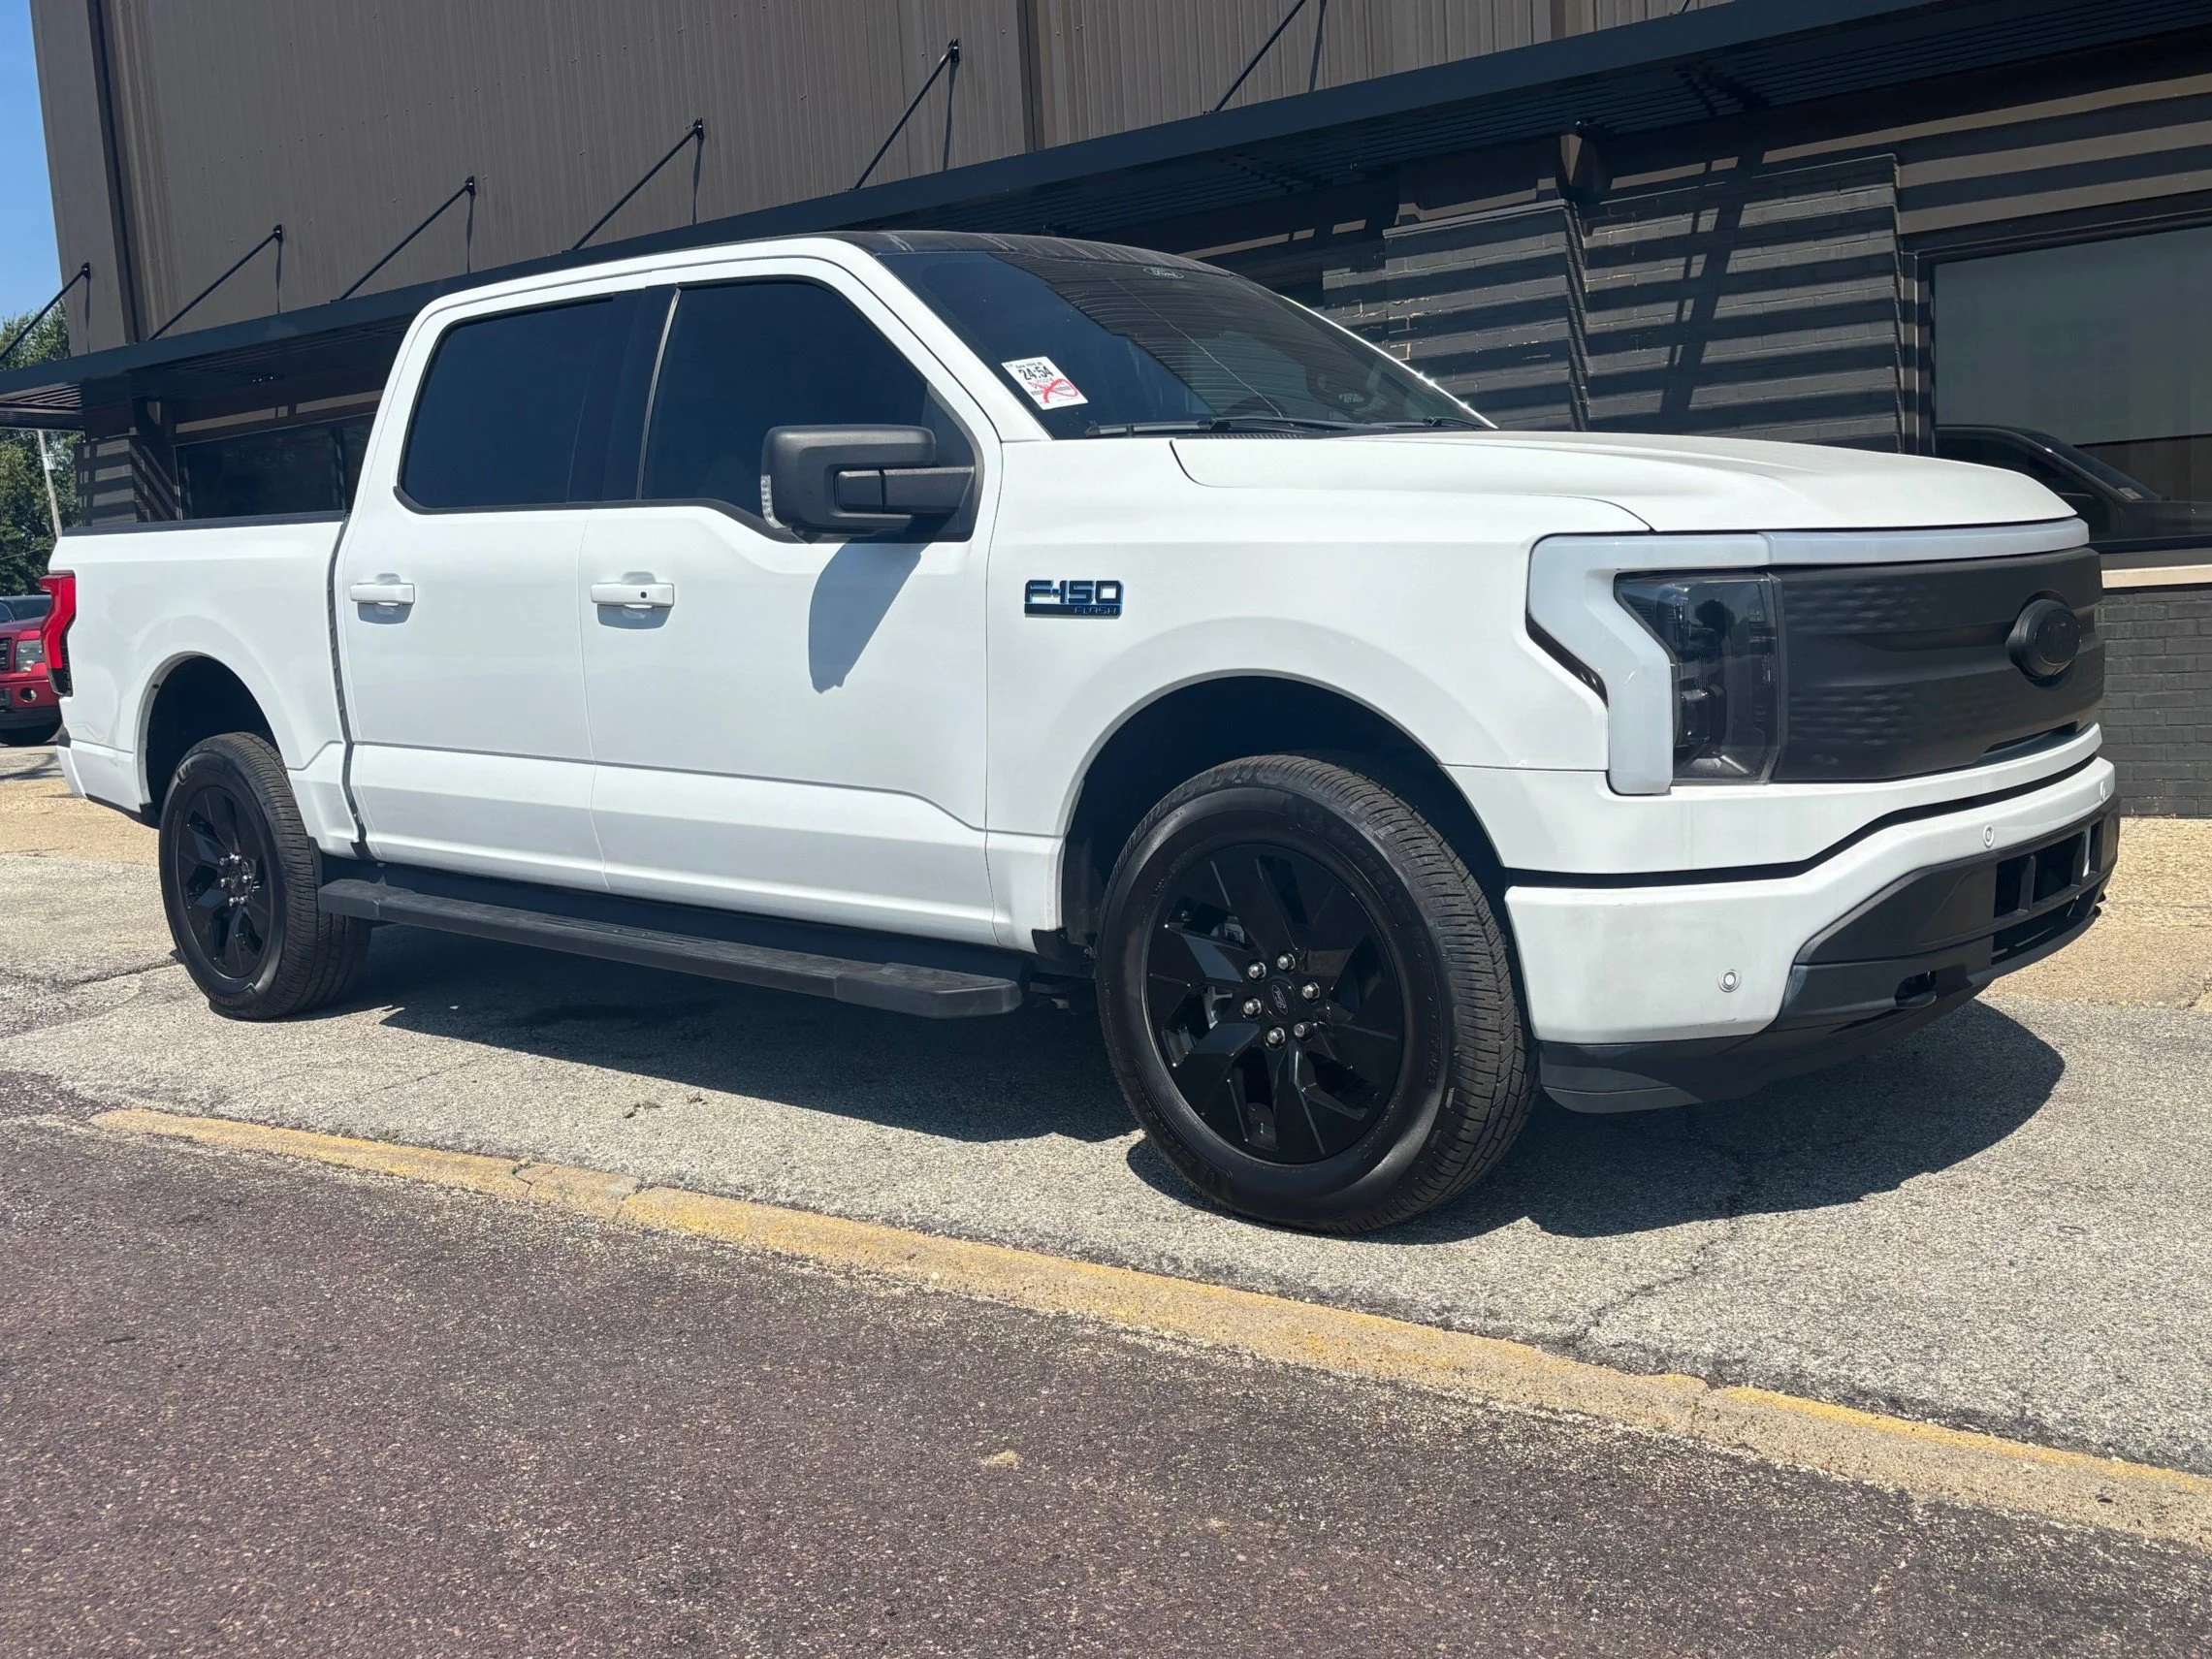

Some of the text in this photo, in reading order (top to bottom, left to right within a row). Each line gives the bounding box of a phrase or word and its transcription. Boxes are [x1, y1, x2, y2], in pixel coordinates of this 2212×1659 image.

[1018, 366, 1054, 381] 24:54
[1024, 579, 1124, 604] F-150
[1074, 606, 1117, 616] FLASH
